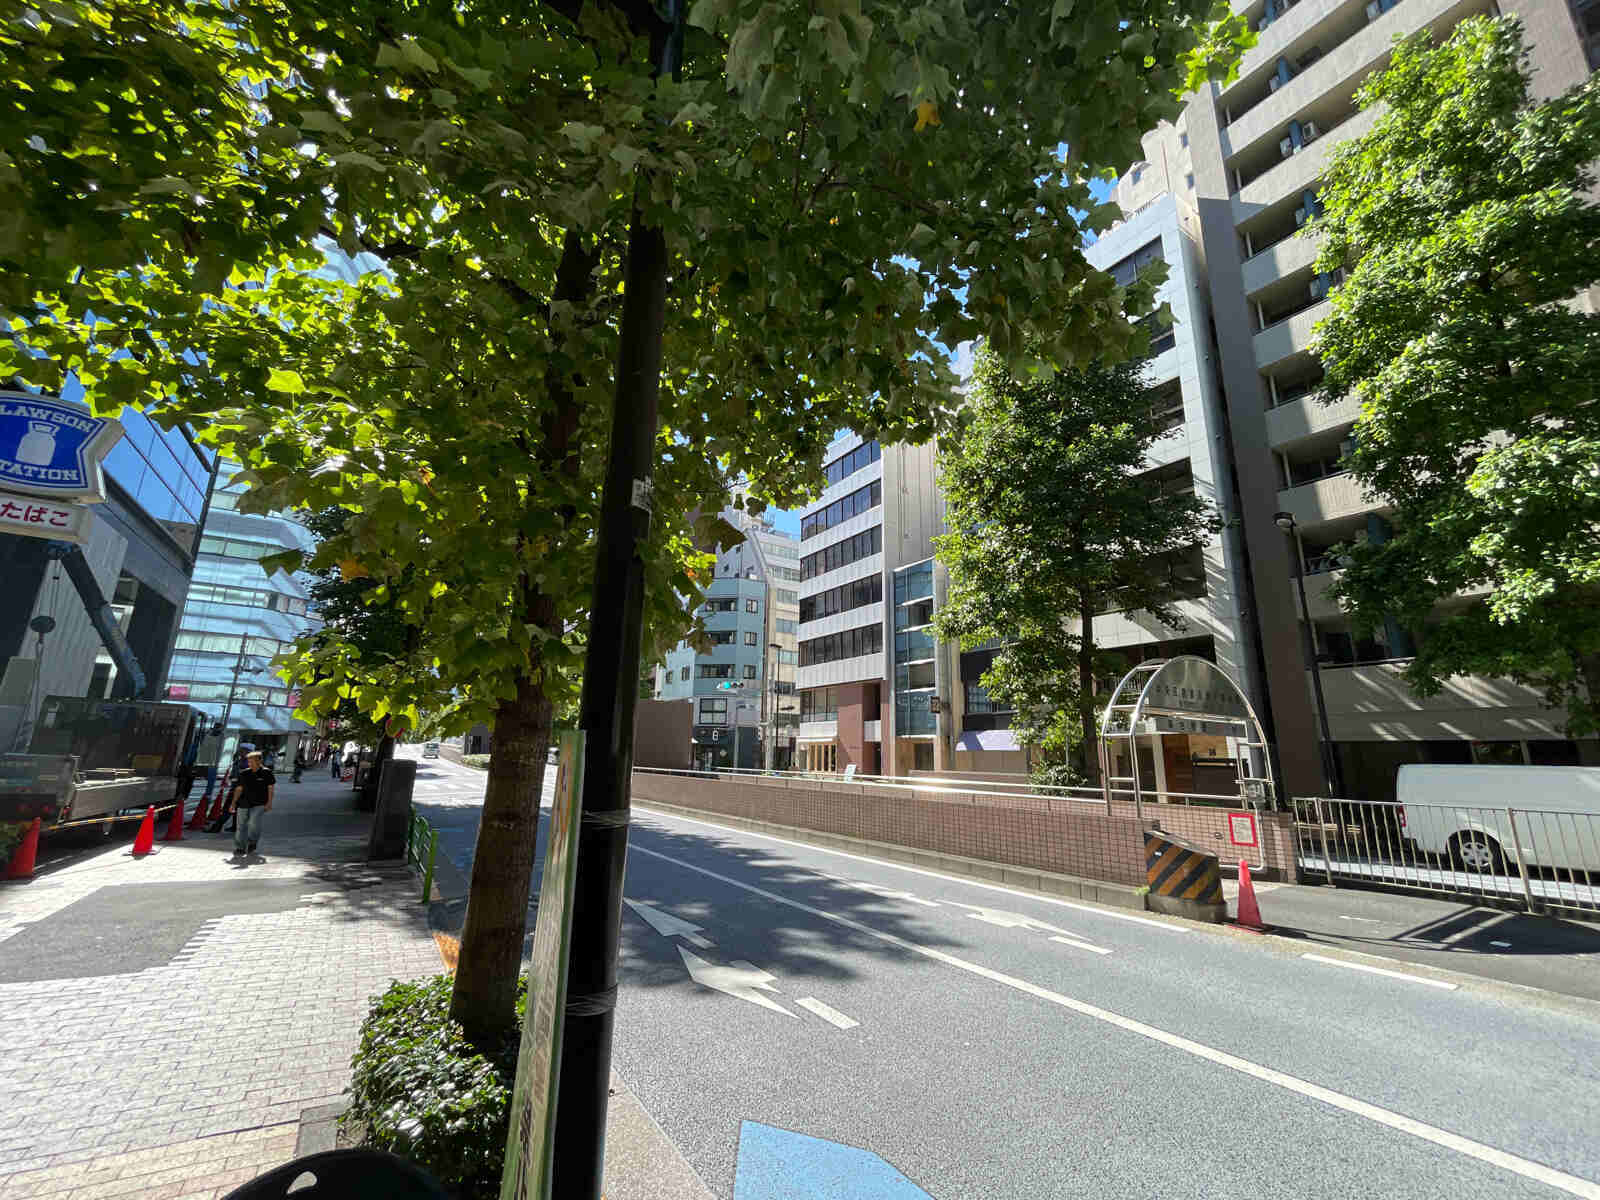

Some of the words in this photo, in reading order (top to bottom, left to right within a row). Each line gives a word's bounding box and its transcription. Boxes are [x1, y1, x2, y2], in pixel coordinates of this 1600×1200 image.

[0, 404, 94, 433] LAWSON
[0, 462, 79, 481] TATION
[0, 501, 70, 526] たばこ
